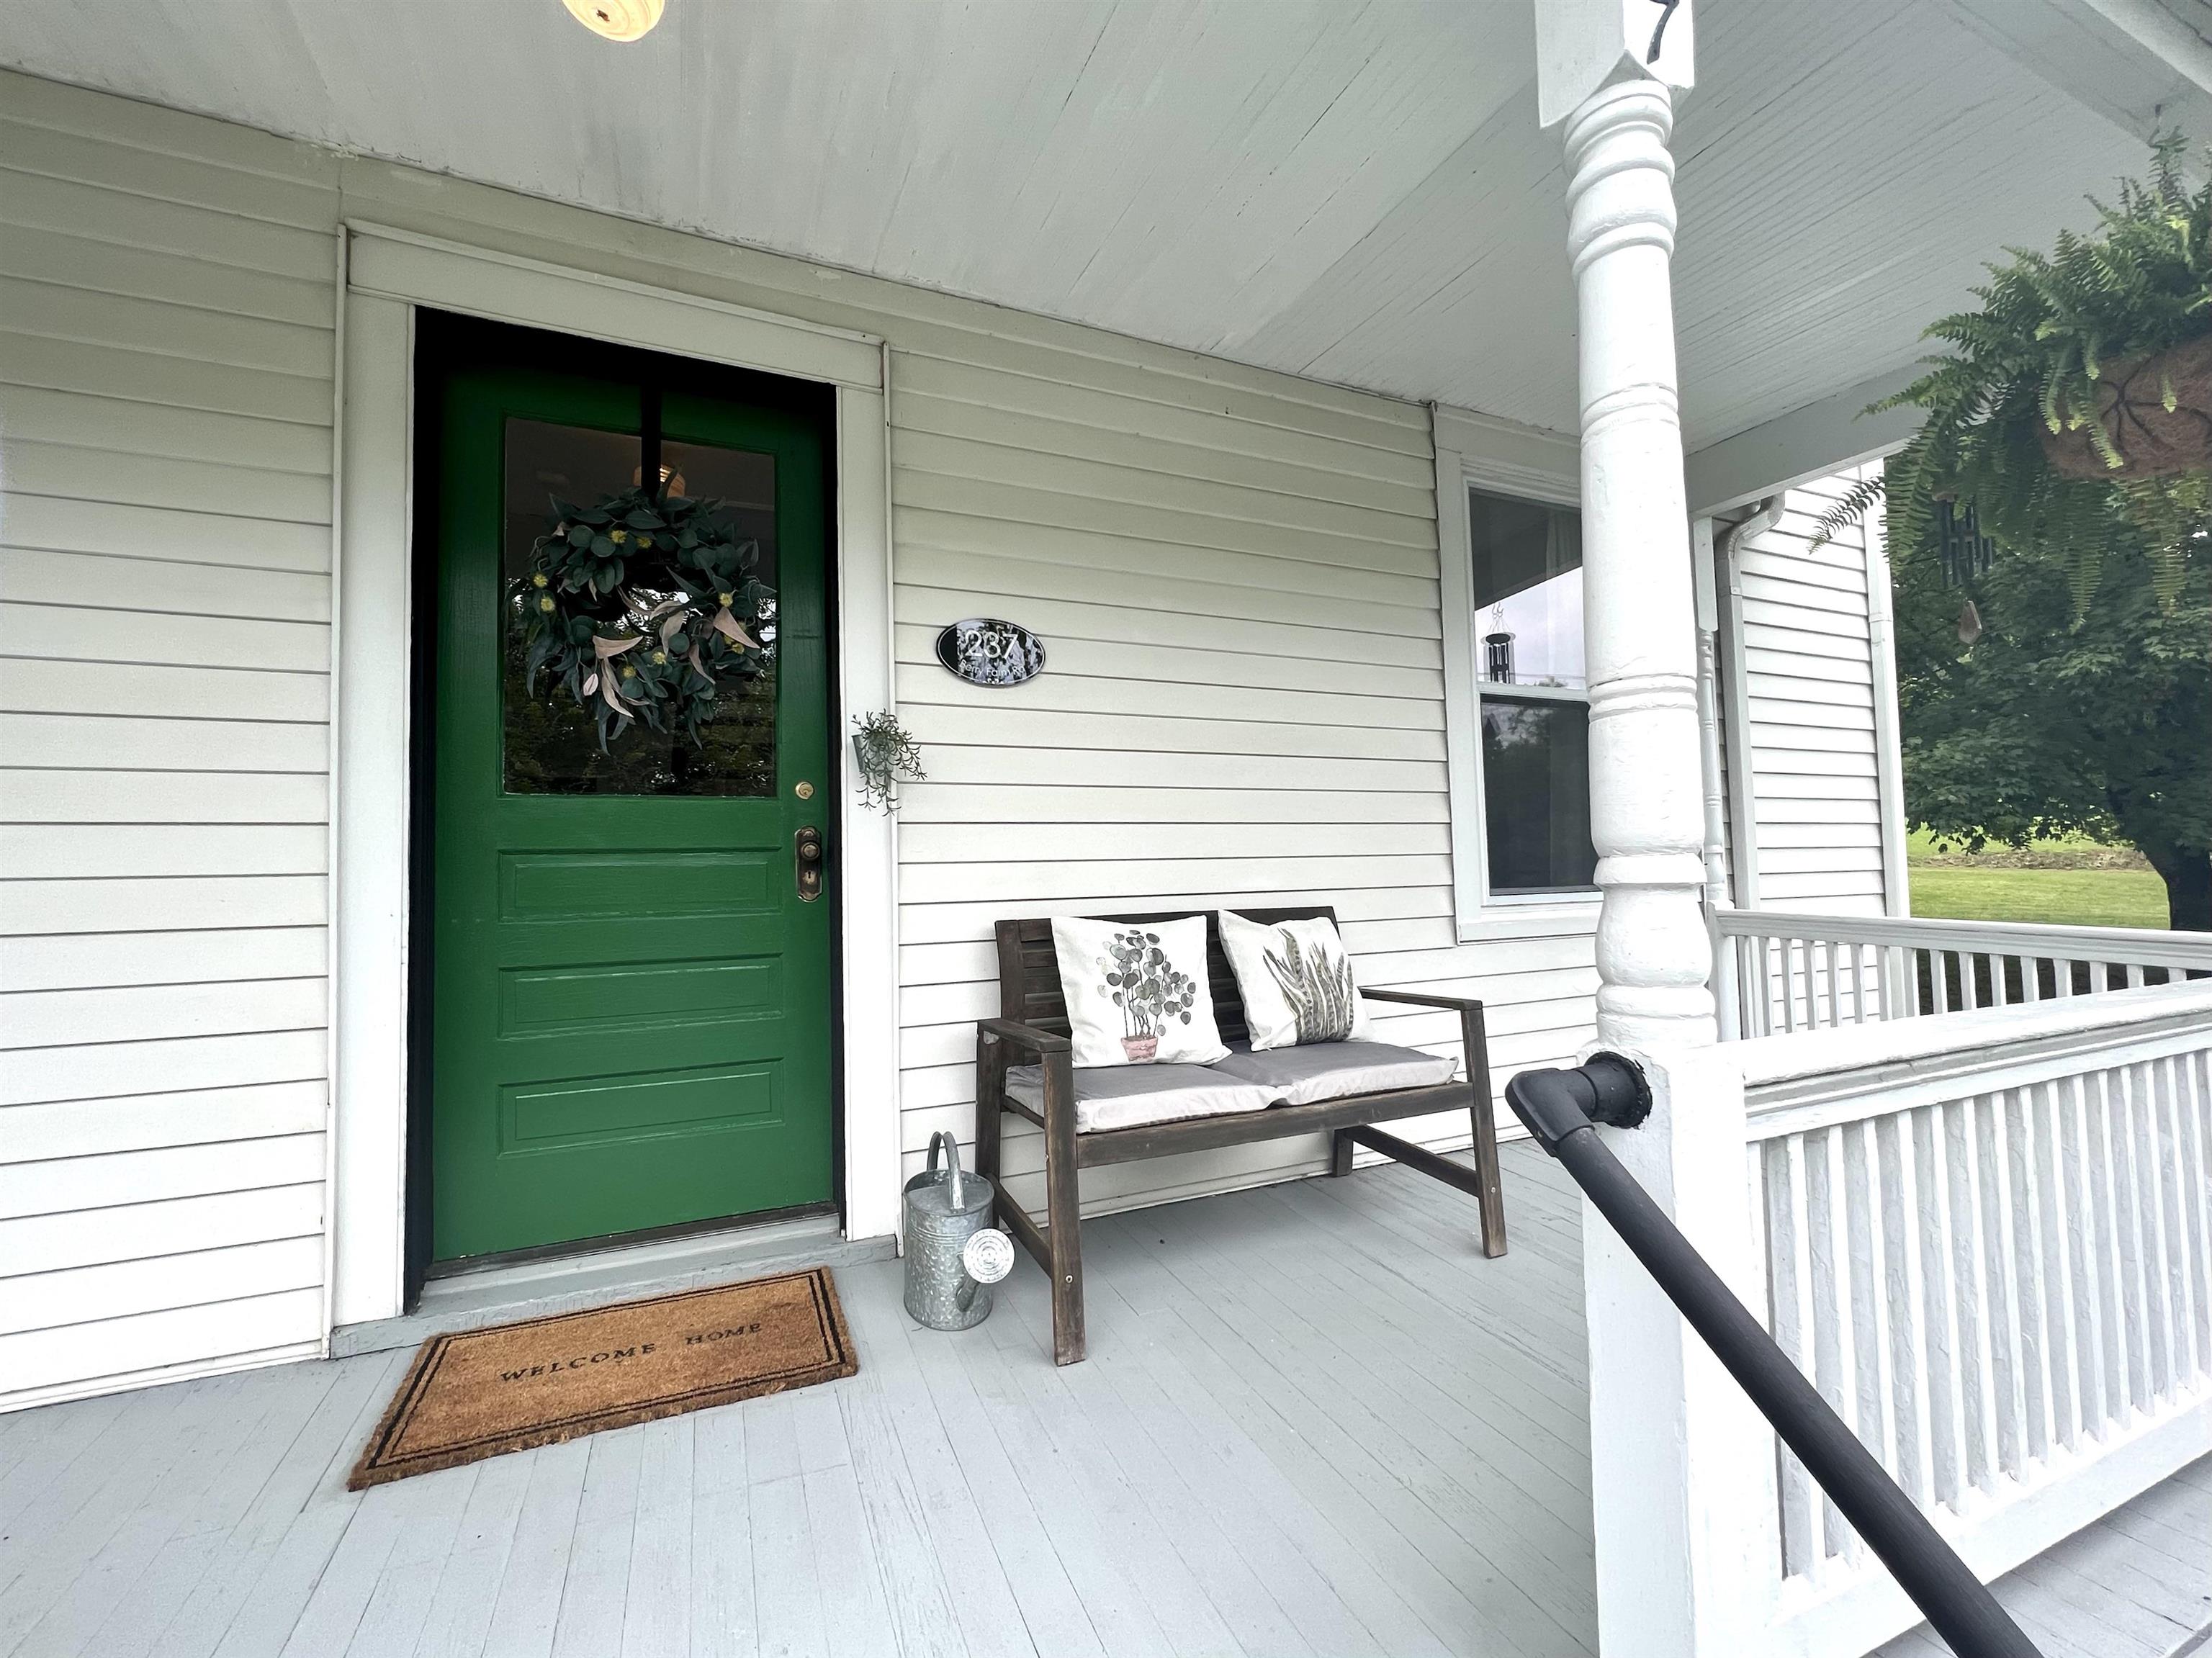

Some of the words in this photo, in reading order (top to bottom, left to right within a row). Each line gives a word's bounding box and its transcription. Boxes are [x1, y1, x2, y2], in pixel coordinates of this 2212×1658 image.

[959, 659, 984, 675] Berry
[986, 667, 1010, 677] Farm
[499, 1343, 657, 1382] WELCOME
[685, 1323, 763, 1345] HOME
